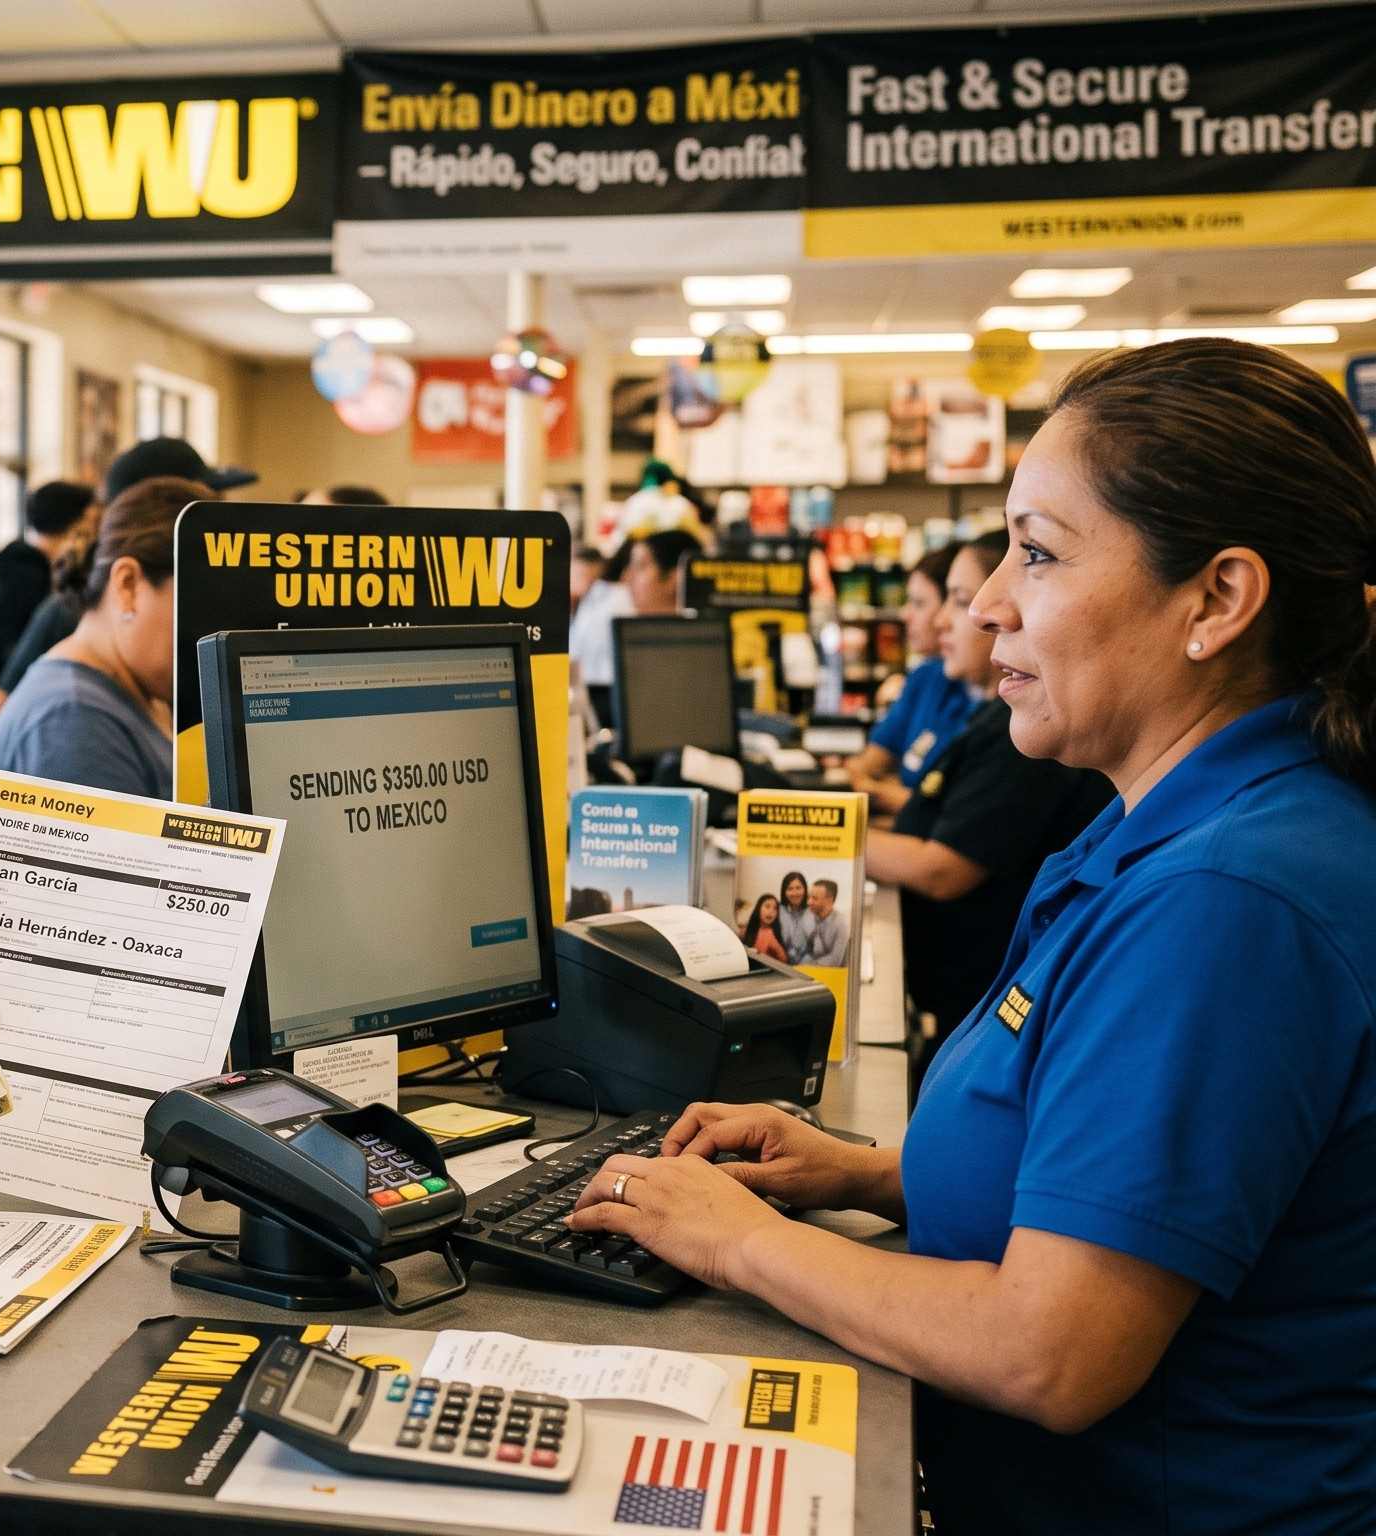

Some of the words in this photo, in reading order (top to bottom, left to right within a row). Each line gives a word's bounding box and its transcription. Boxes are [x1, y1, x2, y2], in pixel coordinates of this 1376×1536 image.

[362, 81, 481, 132] Envía
[490, 80, 638, 129] Dinero
[646, 86, 675, 125] a
[685, 68, 800, 122] Méxi
[847, 65, 950, 115] Fast
[958, 59, 1001, 111] &
[1012, 57, 1190, 109] Secure
[61, 97, 299, 221] WU
[847, 108, 1159, 172] International
[390, 143, 524, 197] Rápido,
[530, 142, 668, 193] Seguro,
[204, 532, 415, 568] WESTERN
[275, 573, 415, 607] UNION
[439, 537, 543, 608] WU
[290, 768, 377, 801] SENDING
[382, 762, 448, 794] $350.00
[452, 758, 489, 785] USD
[40, 796, 95, 818] Money
[344, 806, 371, 833] TO
[376, 798, 447, 830] MEXICO
[48, 826, 89, 842] MEXICO
[227, 827, 263, 848] WU
[581, 835, 677, 854] International
[581, 852, 649, 870] Transfers
[25, 871, 78, 893] García
[166, 894, 230, 917] $250.00
[18, 918, 106, 946] Hernández
[123, 937, 183, 959] Oaxaca
[159, 1330, 261, 1376] WU
[69, 1381, 182, 1475] WESTERN
[138, 1384, 222, 1450] UNION
